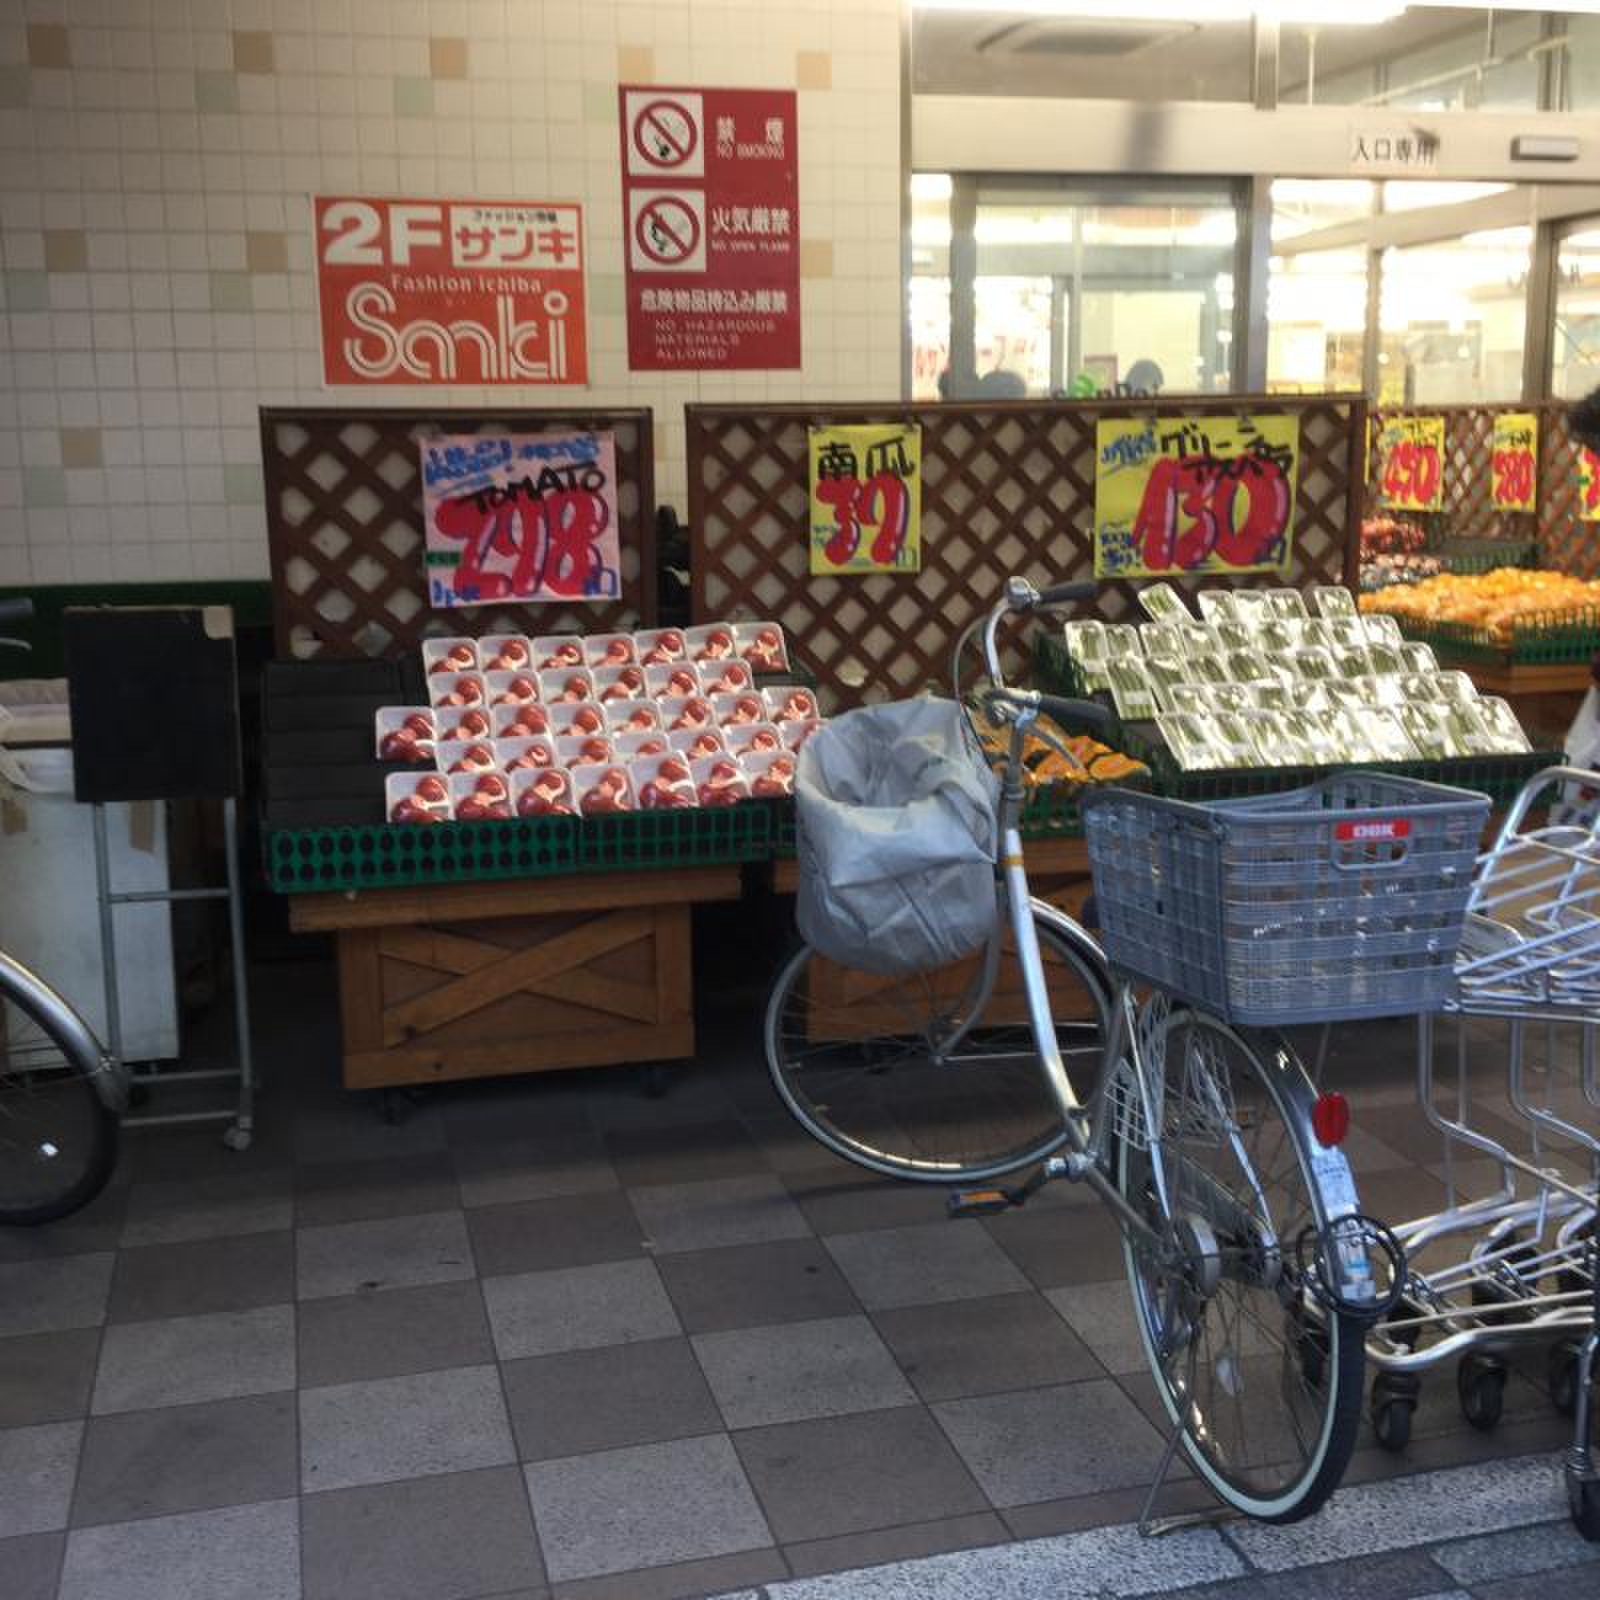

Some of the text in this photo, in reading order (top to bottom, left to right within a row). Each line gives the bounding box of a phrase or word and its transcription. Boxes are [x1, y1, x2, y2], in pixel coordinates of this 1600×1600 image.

[717, 145, 734, 160] NO
[1352, 134, 1437, 165] 入口専用
[322, 200, 443, 266] 2F
[711, 206, 791, 236] 火気厳禁
[455, 225, 577, 264] サンキ
[391, 273, 473, 292] Fashion
[344, 281, 568, 380] Sanki
[655, 320, 675, 332] NO
[456, 460, 606, 513] TOMATO
[816, 470, 911, 566] 39
[435, 484, 609, 598] 298
